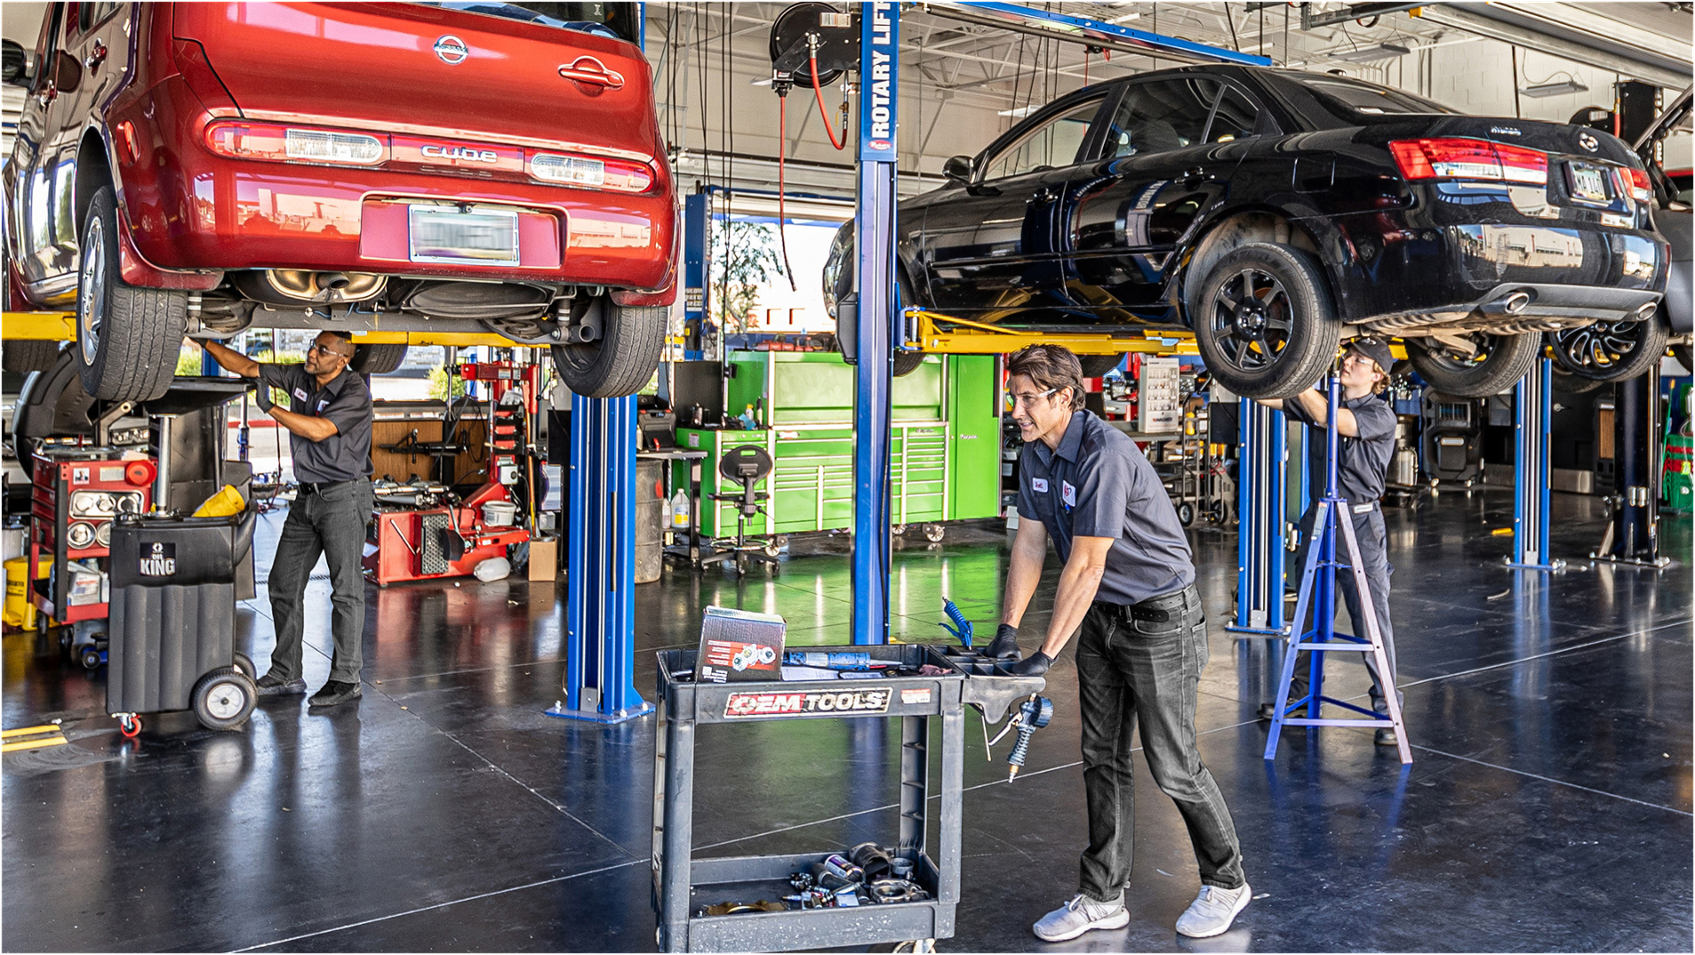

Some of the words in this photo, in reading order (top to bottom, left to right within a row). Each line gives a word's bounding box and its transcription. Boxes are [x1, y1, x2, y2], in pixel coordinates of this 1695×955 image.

[872, 0, 891, 45] LIFT
[871, 50, 891, 138] ROTARY
[421, 146, 498, 163] cube
[140, 558, 176, 576] KING
[731, 694, 801, 714] OEM
[805, 691, 886, 711] TOOLS
